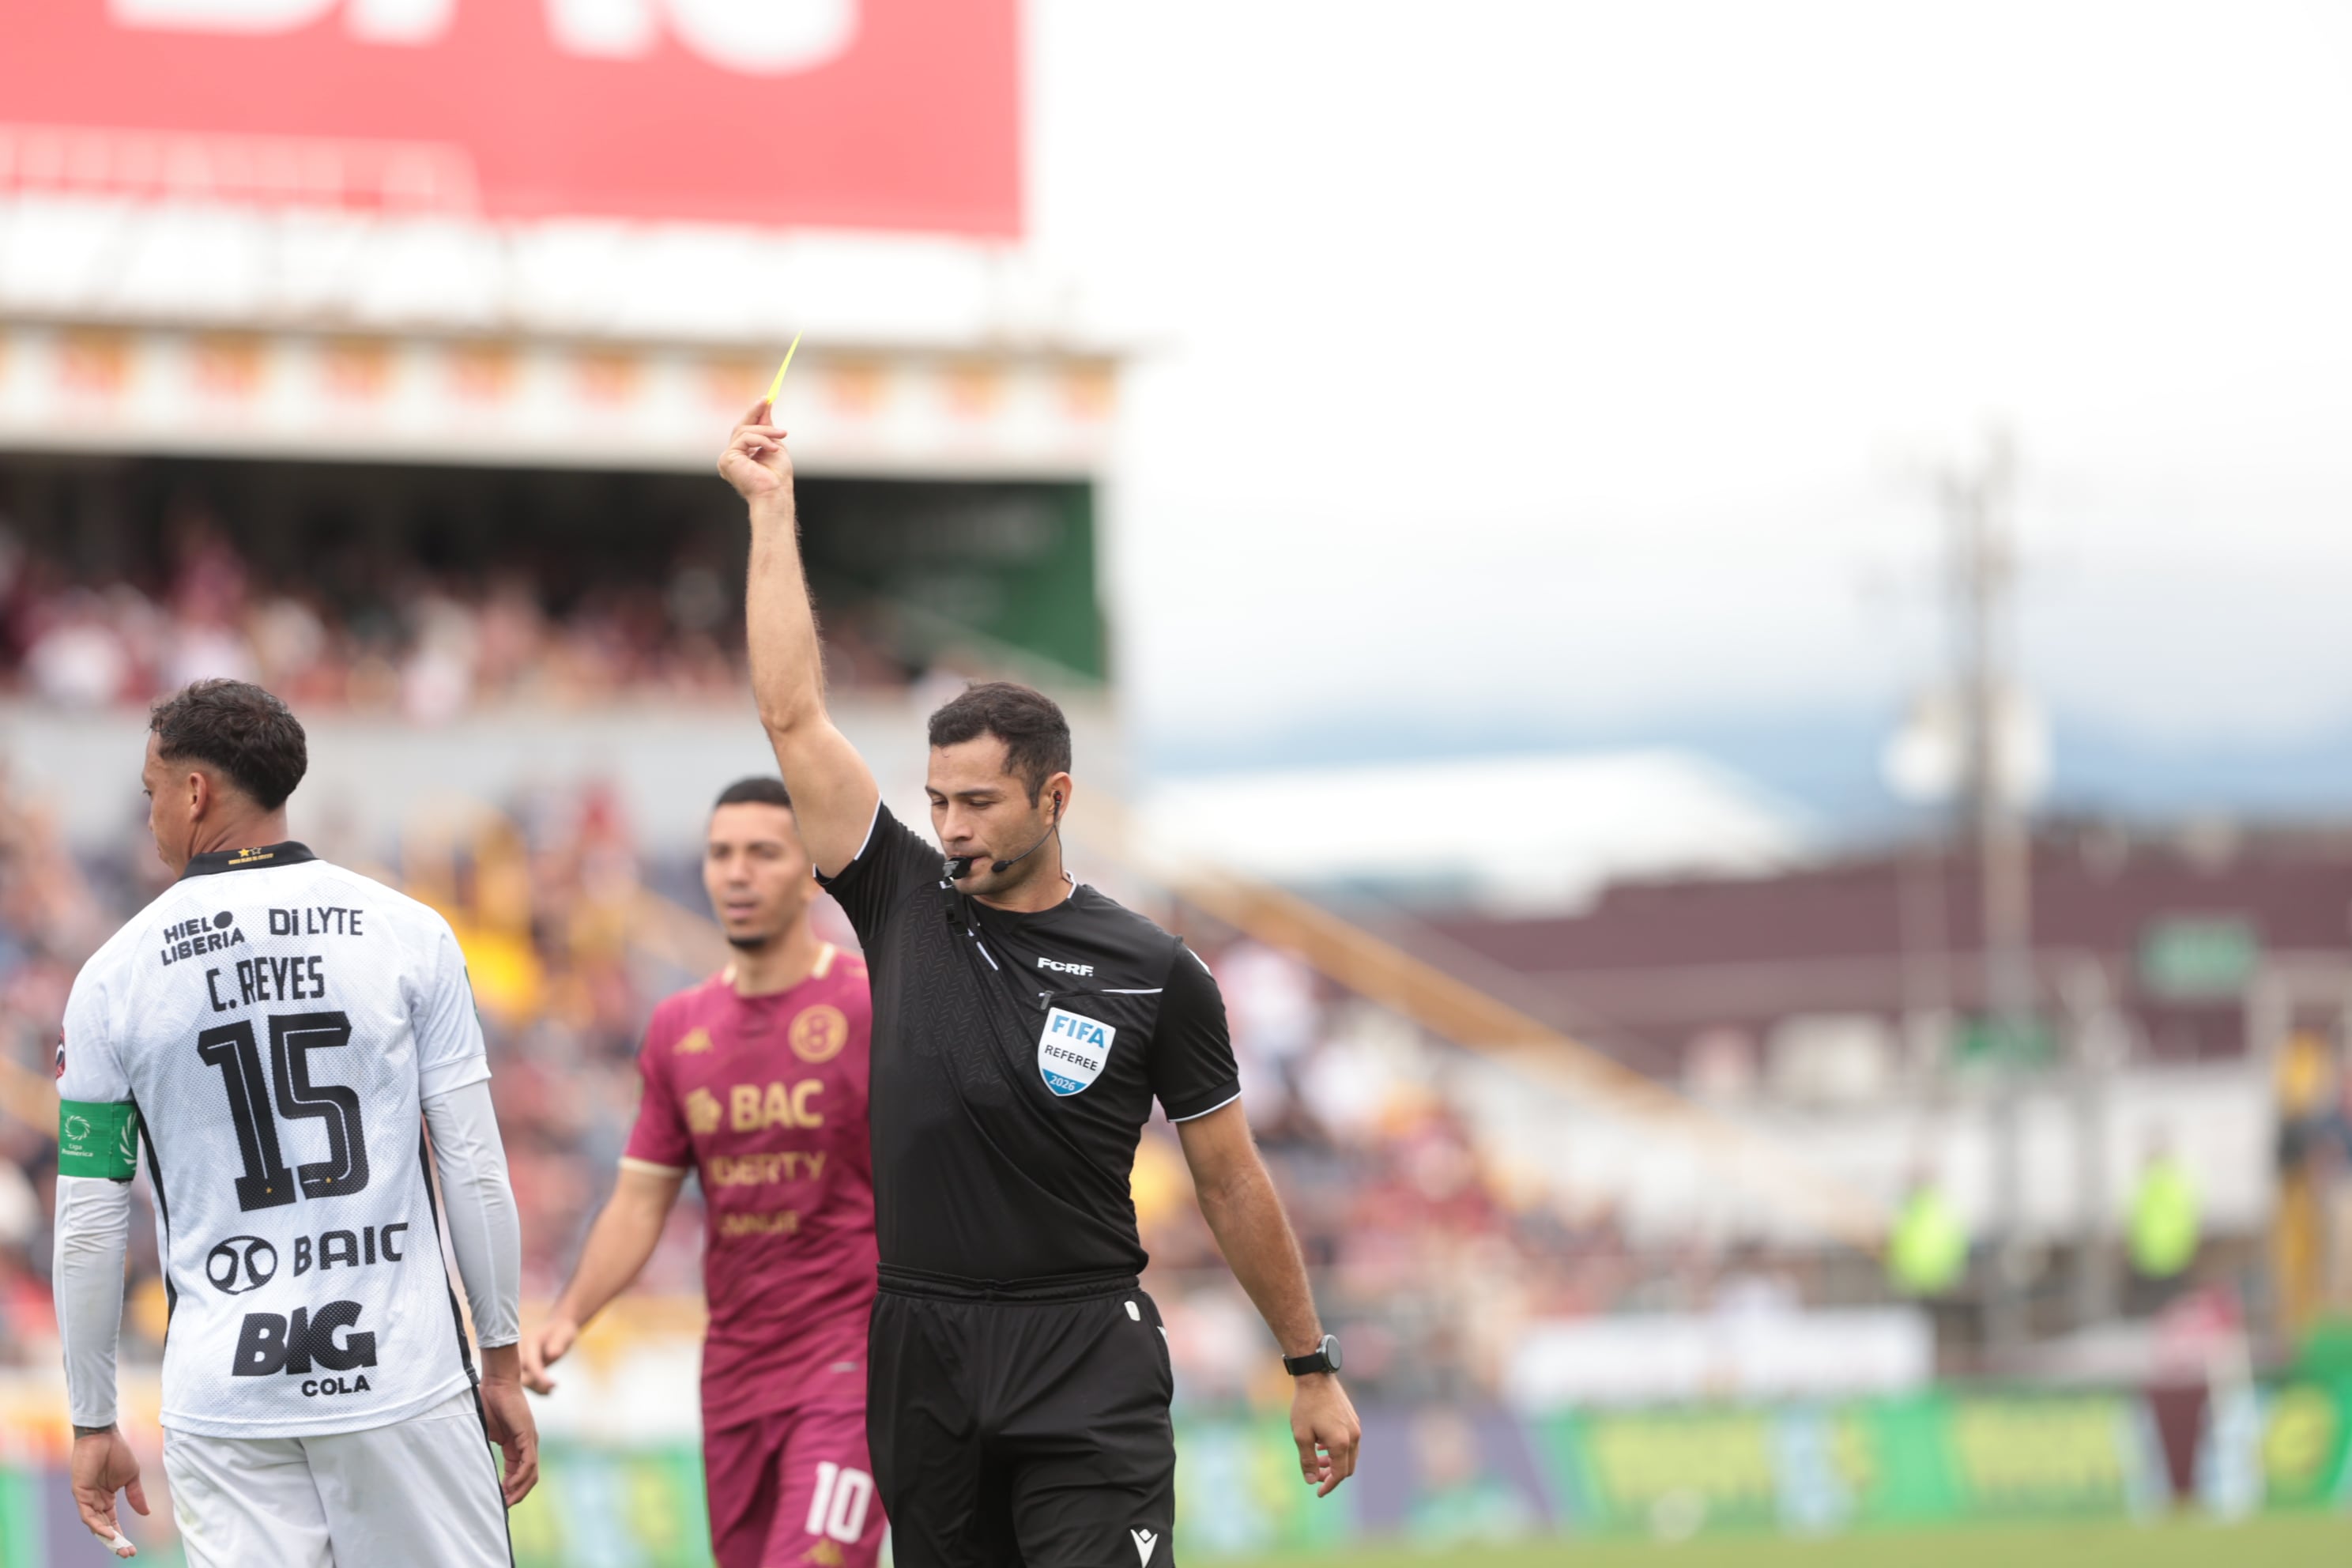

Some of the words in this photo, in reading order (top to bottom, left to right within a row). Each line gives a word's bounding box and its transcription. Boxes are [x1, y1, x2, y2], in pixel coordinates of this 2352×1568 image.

[307, 906, 364, 936] LYTE
[160, 927, 245, 967] LIBERIA
[1051, 1014, 1104, 1049] FIFA
[1044, 1044, 1099, 1072] REFEREE
[1049, 1074, 1076, 1091] 2026
[197, 1010, 370, 1212] 15
[729, 1078, 824, 1133] BAC
[293, 1222, 409, 1278] BAIC
[232, 1300, 378, 1377] BIG
[301, 1374, 371, 1397] COLA
[805, 1460, 874, 1544] 10
